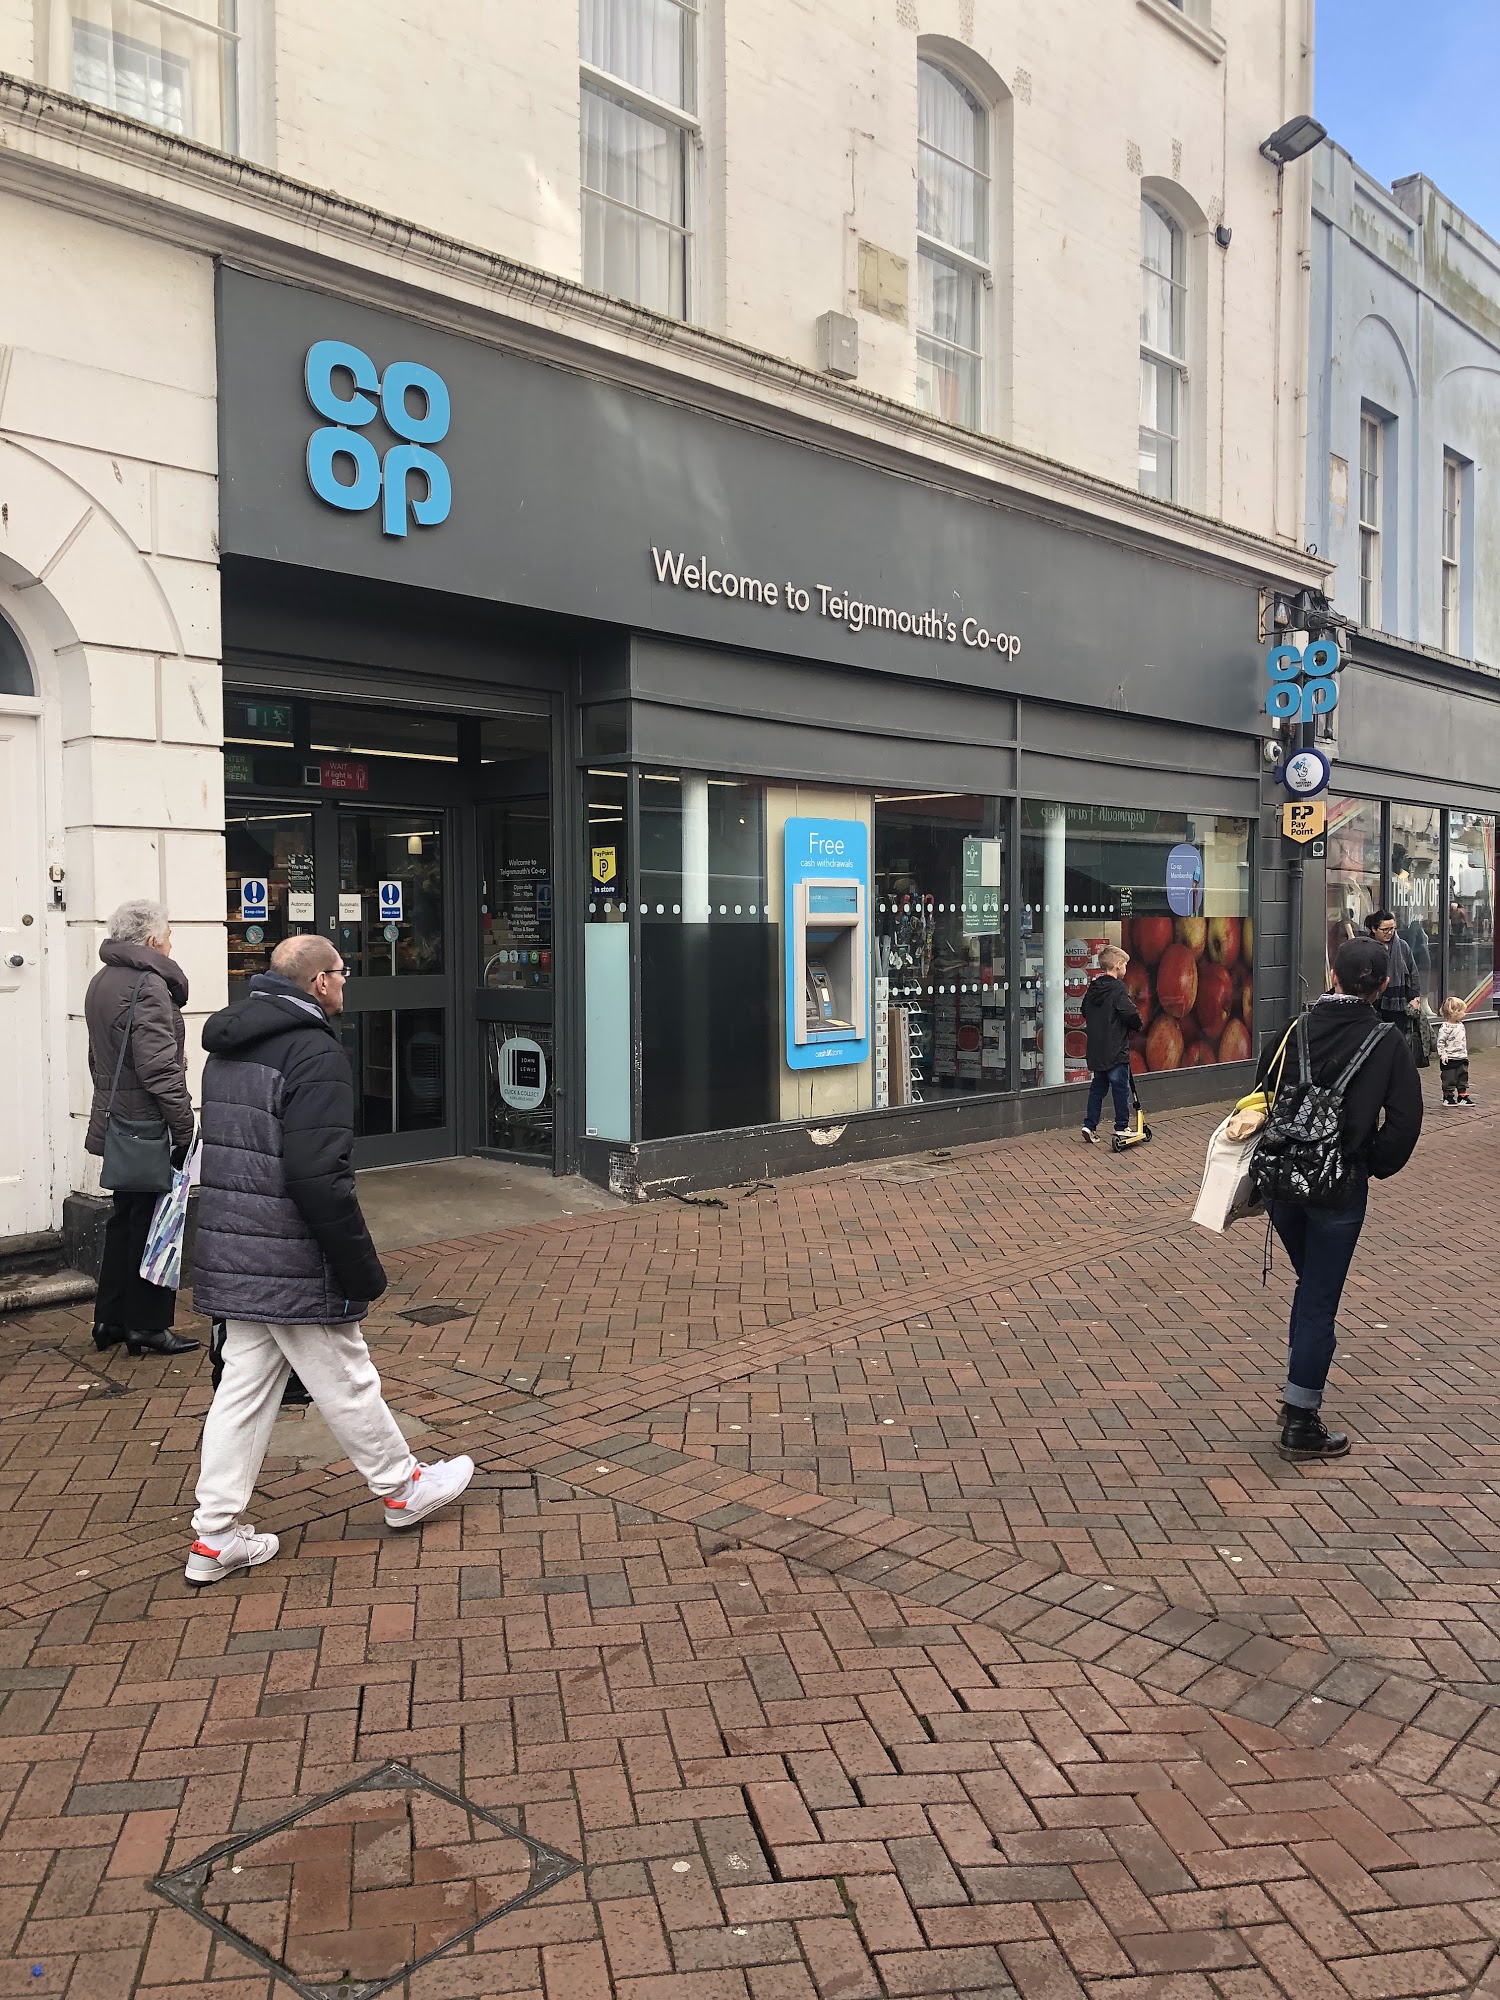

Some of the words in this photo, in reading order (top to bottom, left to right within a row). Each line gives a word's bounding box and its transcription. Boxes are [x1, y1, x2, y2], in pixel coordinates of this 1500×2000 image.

[651, 546, 779, 606] Welcome
[784, 581, 810, 612] to
[814, 584, 957, 642] Teignmouth's
[961, 617, 1021, 662] Co-op
[224, 764, 240, 772] light
[330, 762, 348, 770] WAIT
[1291, 821, 1306, 829] Pay
[809, 832, 844, 855] Free
[800, 858, 815, 867] cash
[817, 858, 853, 868] withdrawals
[1171, 863, 1182, 871] Co-op
[500, 868, 530, 877] Teignmouth's
[531, 867, 546, 875] Co-op
[1171, 872, 1193, 880] Membership
[1392, 877, 1408, 906] THE
[1410, 878, 1427, 906] JOY
[1429, 878, 1440, 906] OF
